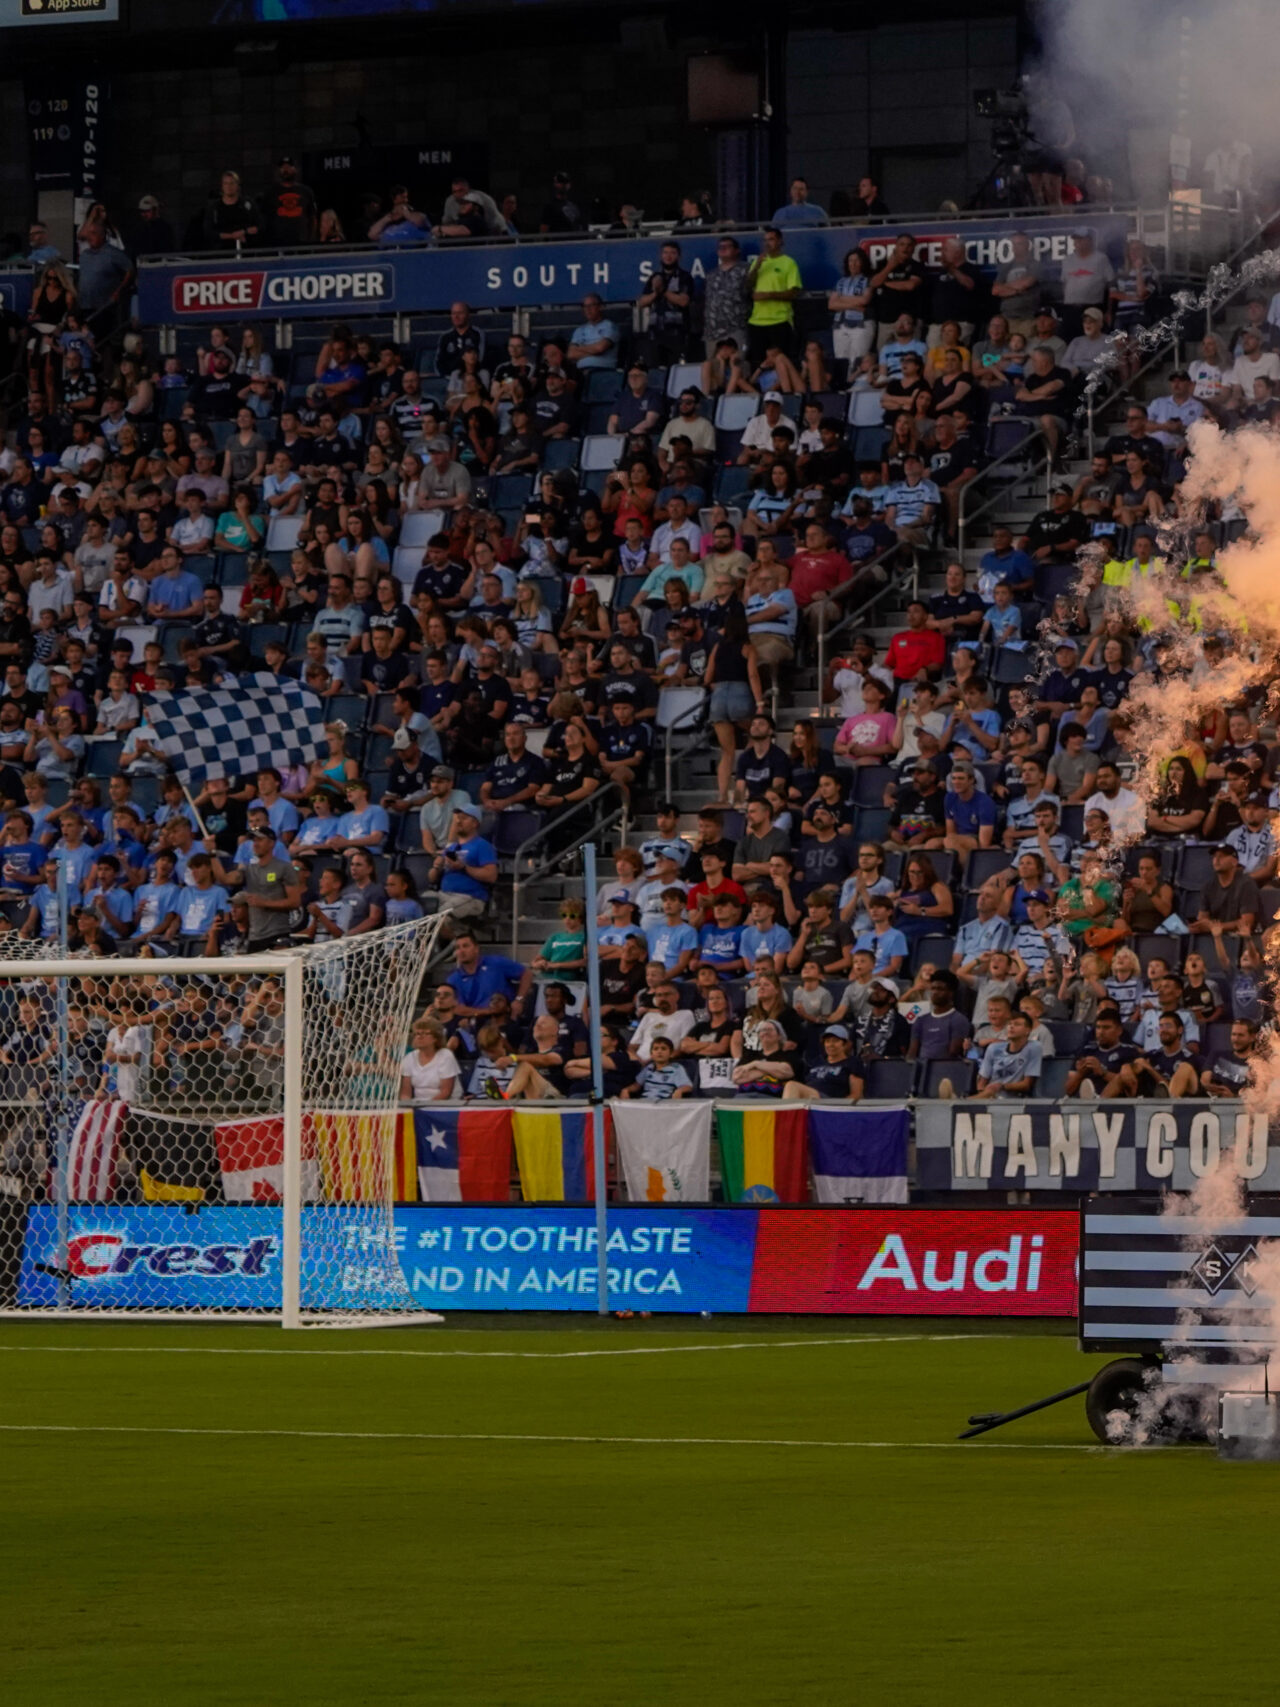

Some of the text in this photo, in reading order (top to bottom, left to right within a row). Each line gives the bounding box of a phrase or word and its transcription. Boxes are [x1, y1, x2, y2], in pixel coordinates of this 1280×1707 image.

[48, 0, 71, 11] App
[47, 99, 69, 112] 120
[33, 128, 54, 141] 119
[324, 155, 351, 171] MEN
[418, 150, 452, 165] MEN
[487, 261, 609, 289] SOUTH
[183, 272, 384, 306] PRICE CHOPPER
[806, 849, 839, 868] 816
[953, 1112, 1125, 1179] MANY
[343, 1226, 408, 1251] THE
[417, 1227, 452, 1252] #1
[66, 1234, 276, 1277] Crest
[857, 1234, 1045, 1292] Audi
[474, 1267, 510, 1293] IN
[517, 1267, 683, 1295] AMERICA
